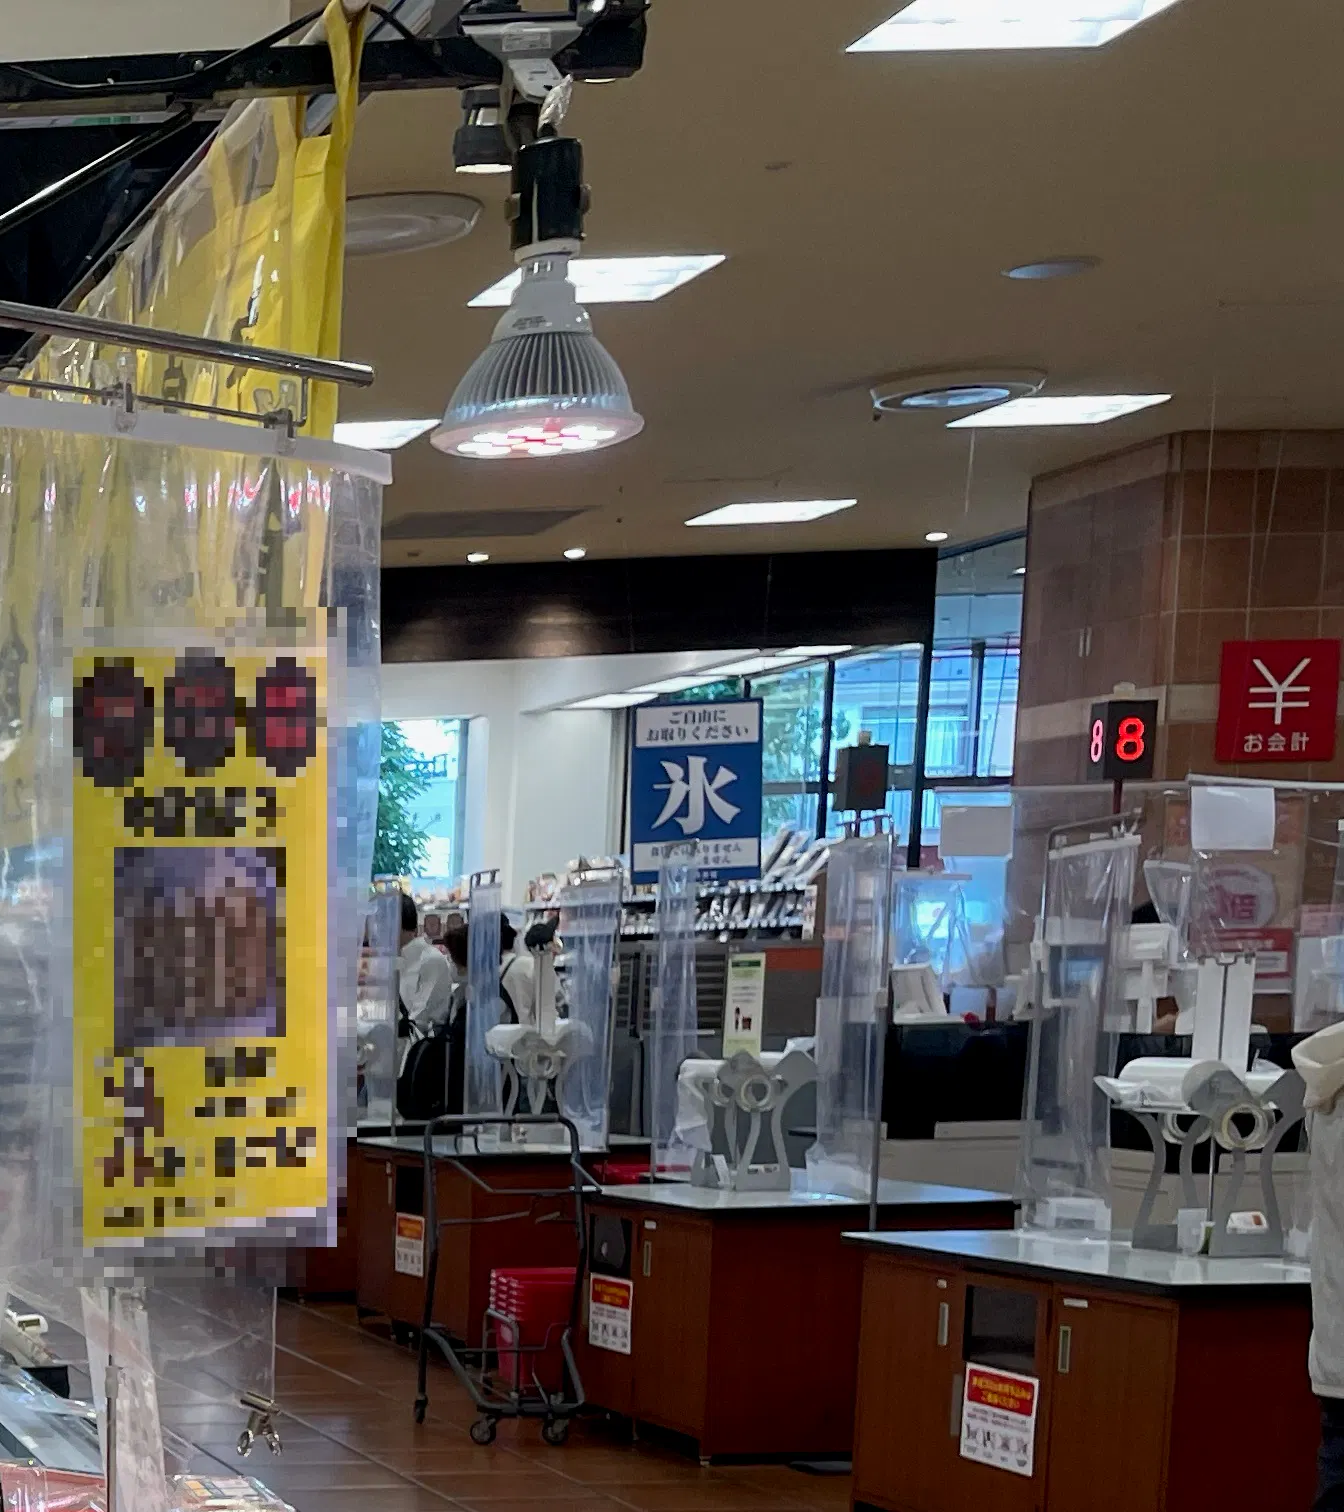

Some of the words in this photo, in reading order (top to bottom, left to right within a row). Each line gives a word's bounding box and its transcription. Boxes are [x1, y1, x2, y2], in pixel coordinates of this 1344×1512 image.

[669, 708, 727, 725] ご自由に
[646, 725, 749, 742] お取りください
[1116, 717, 1145, 761] 8
[1243, 731, 1310, 753] お会計
[650, 755, 742, 836] 氷
